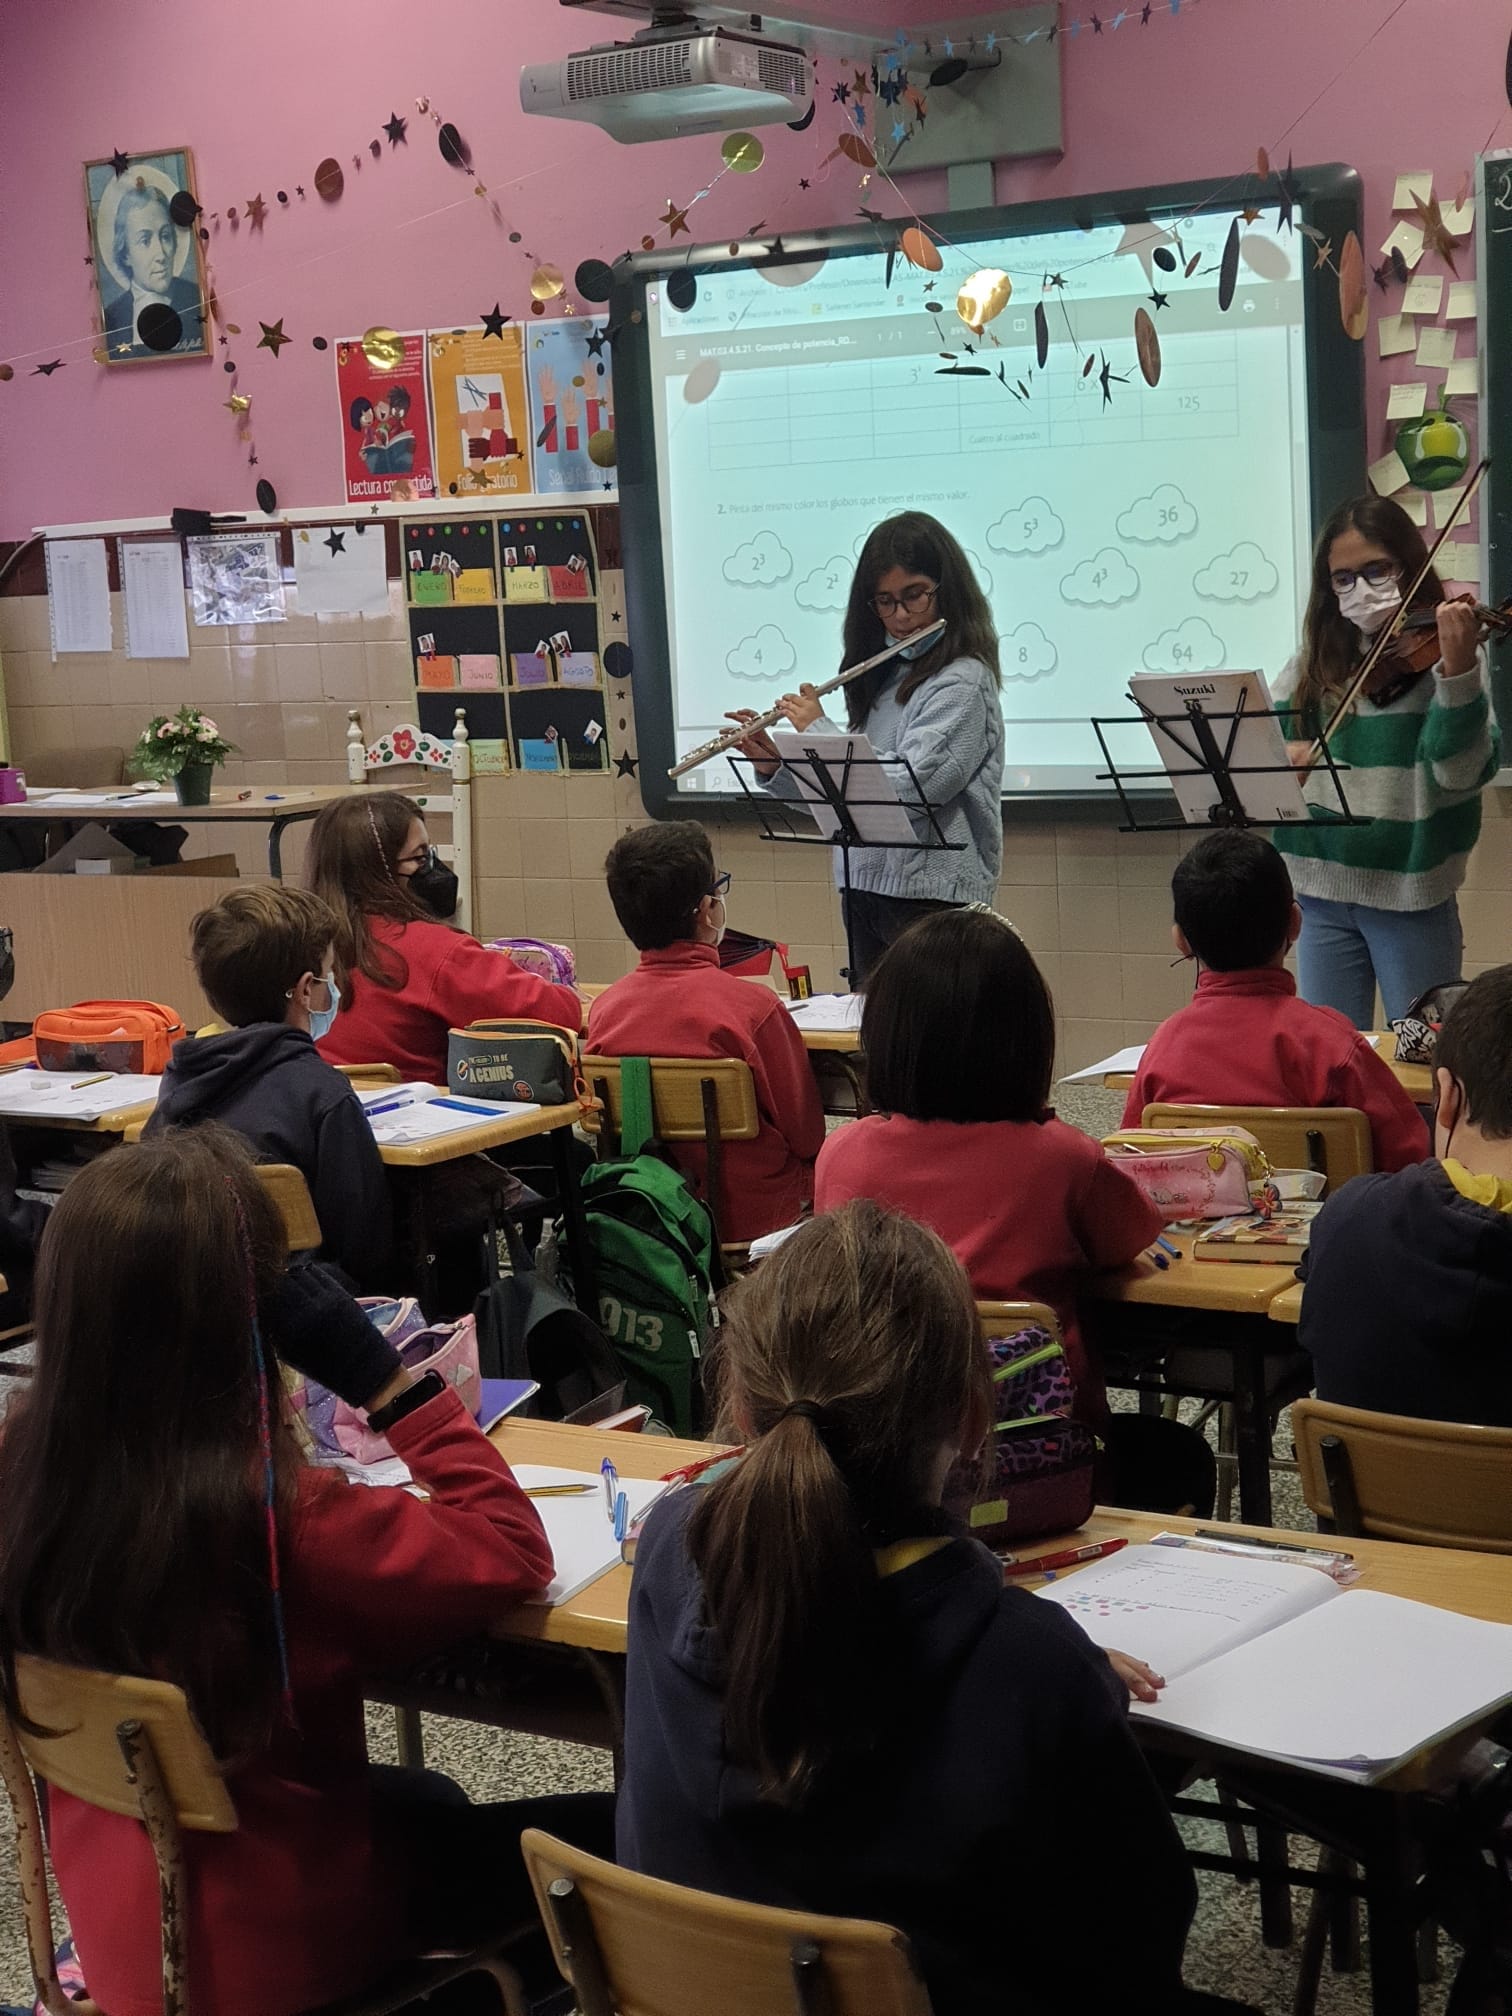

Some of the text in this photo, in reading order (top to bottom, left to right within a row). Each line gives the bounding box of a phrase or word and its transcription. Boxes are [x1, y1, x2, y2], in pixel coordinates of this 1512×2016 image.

[791, 340, 802, 349] de
[1077, 377, 1087, 391] 6
[1178, 396, 1200, 411] 125
[348, 479, 382, 496] Lectura
[765, 501, 792, 513] mismo
[793, 499, 815, 511] color
[816, 498, 829, 509] los
[829, 496, 859, 511] globos
[859, 496, 877, 508] que
[877, 493, 906, 505] tienen
[907, 492, 915, 503] el
[915, 491, 945, 502] mismo
[1158, 506, 1179, 527] 36
[512, 581, 539, 591] MARZO
[1230, 571, 1249, 586] 27
[753, 648, 763, 665] 4
[1019, 647, 1028, 663] 8
[1172, 642, 1193, 662] 64
[468, 669, 493, 680] JUNIO
[1173, 683, 1217, 697] Suzuki
[469, 1064, 515, 1084] A GENIUS
